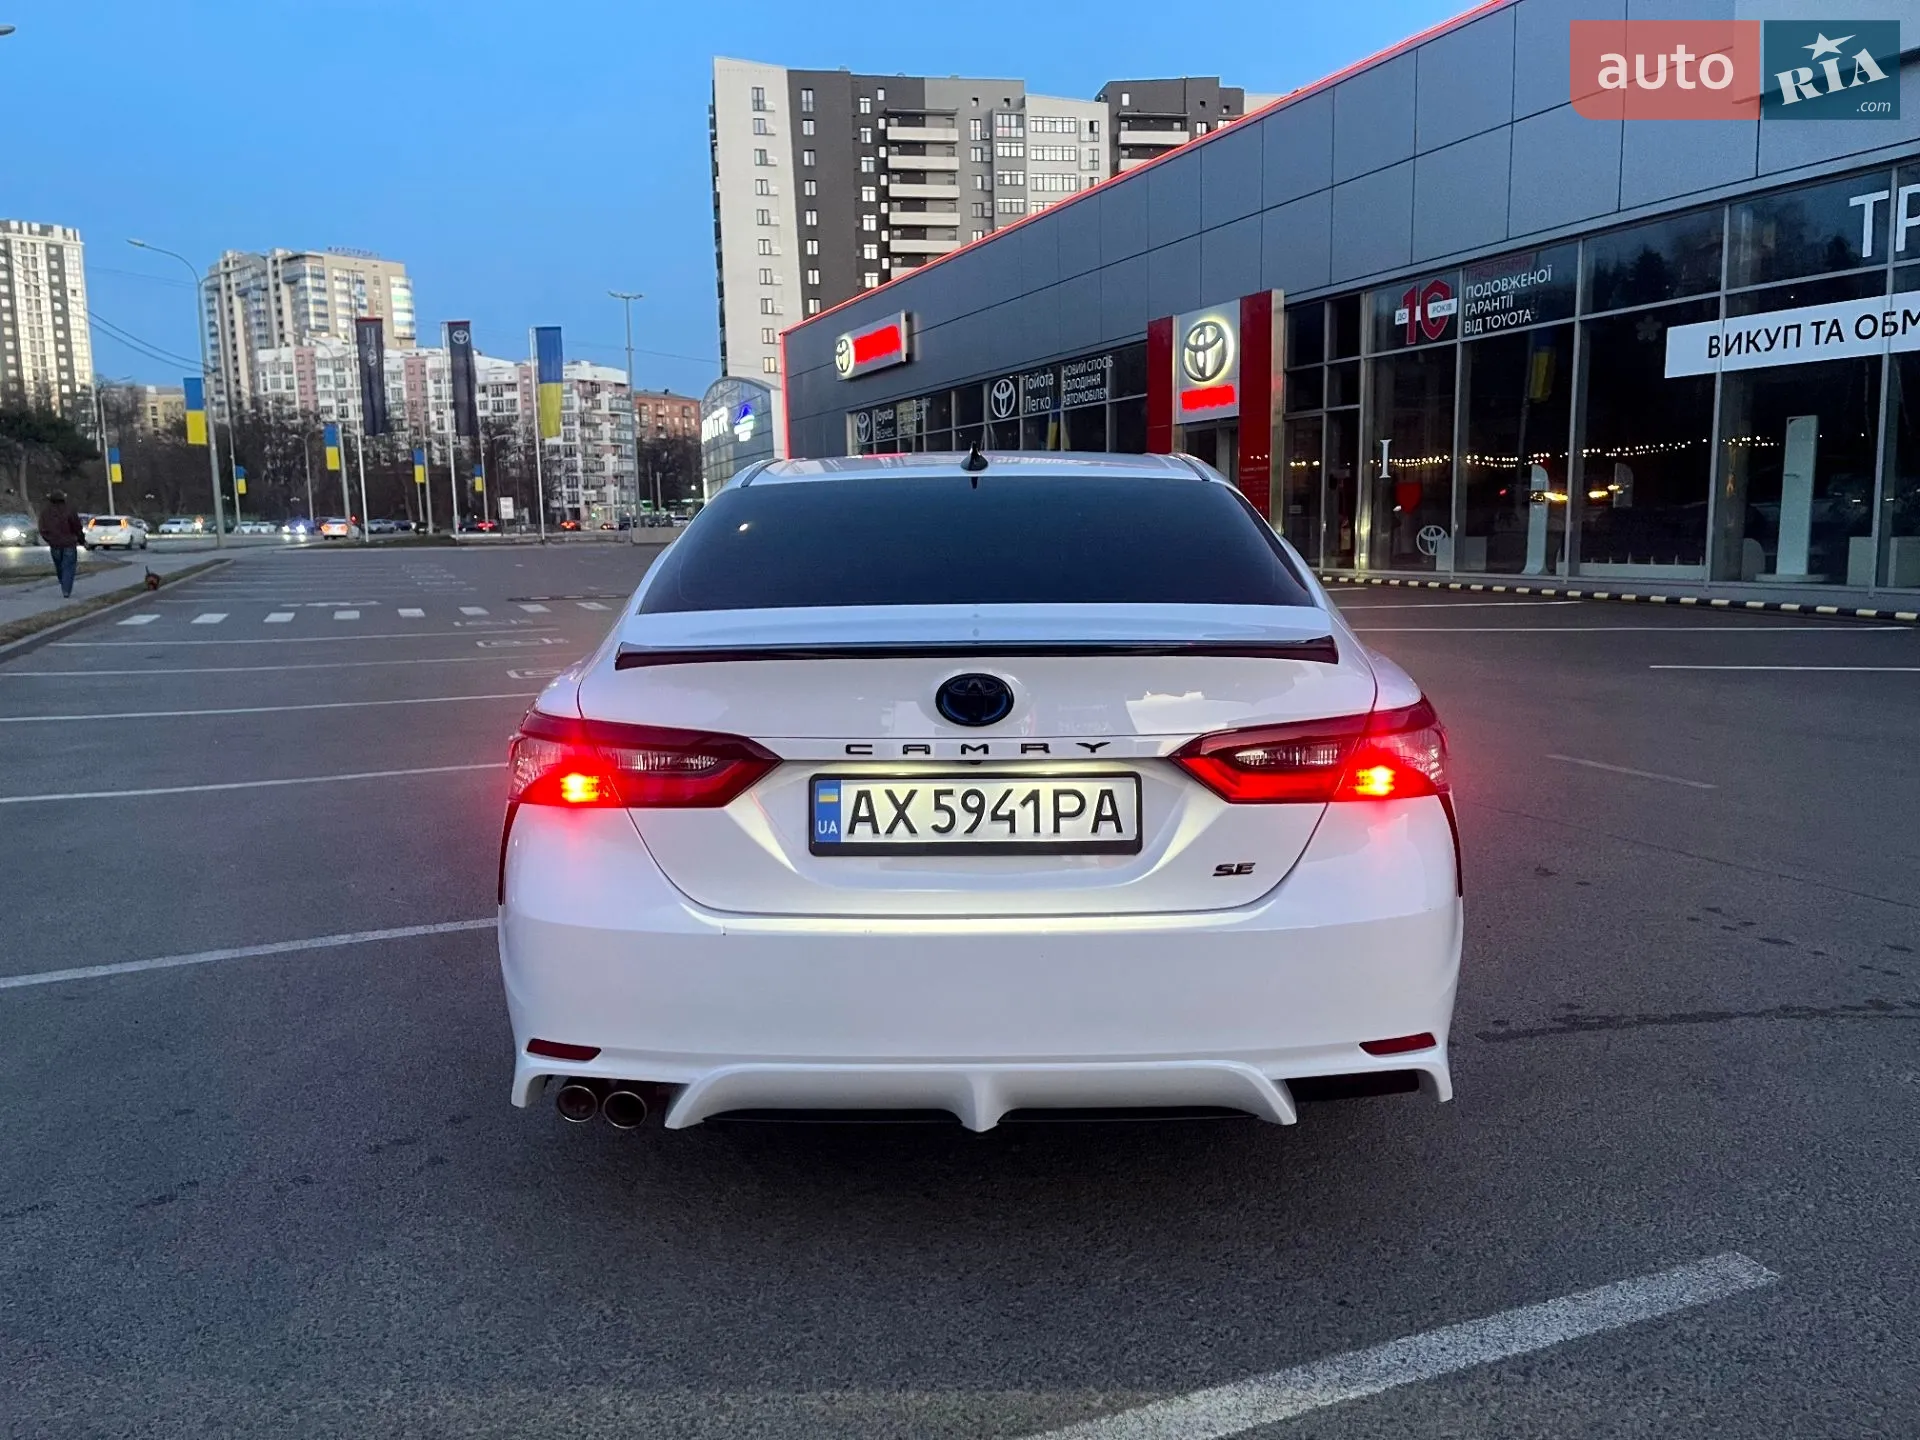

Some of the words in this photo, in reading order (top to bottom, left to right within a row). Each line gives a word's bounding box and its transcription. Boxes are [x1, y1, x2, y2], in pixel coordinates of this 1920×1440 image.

[1465, 265, 1552, 299] ПОДОВЖЕНОЇ
[1465, 291, 1515, 317] ГАРАНТІЇ
[1464, 318, 1483, 334] ВІД
[1708, 323, 1801, 359] ВИКУП
[1811, 318, 1844, 346] ТА
[1024, 396, 1051, 413] Легко
[845, 741, 1111, 755] CAMRY
[818, 821, 838, 834] UA
[1212, 862, 1256, 876] SE
